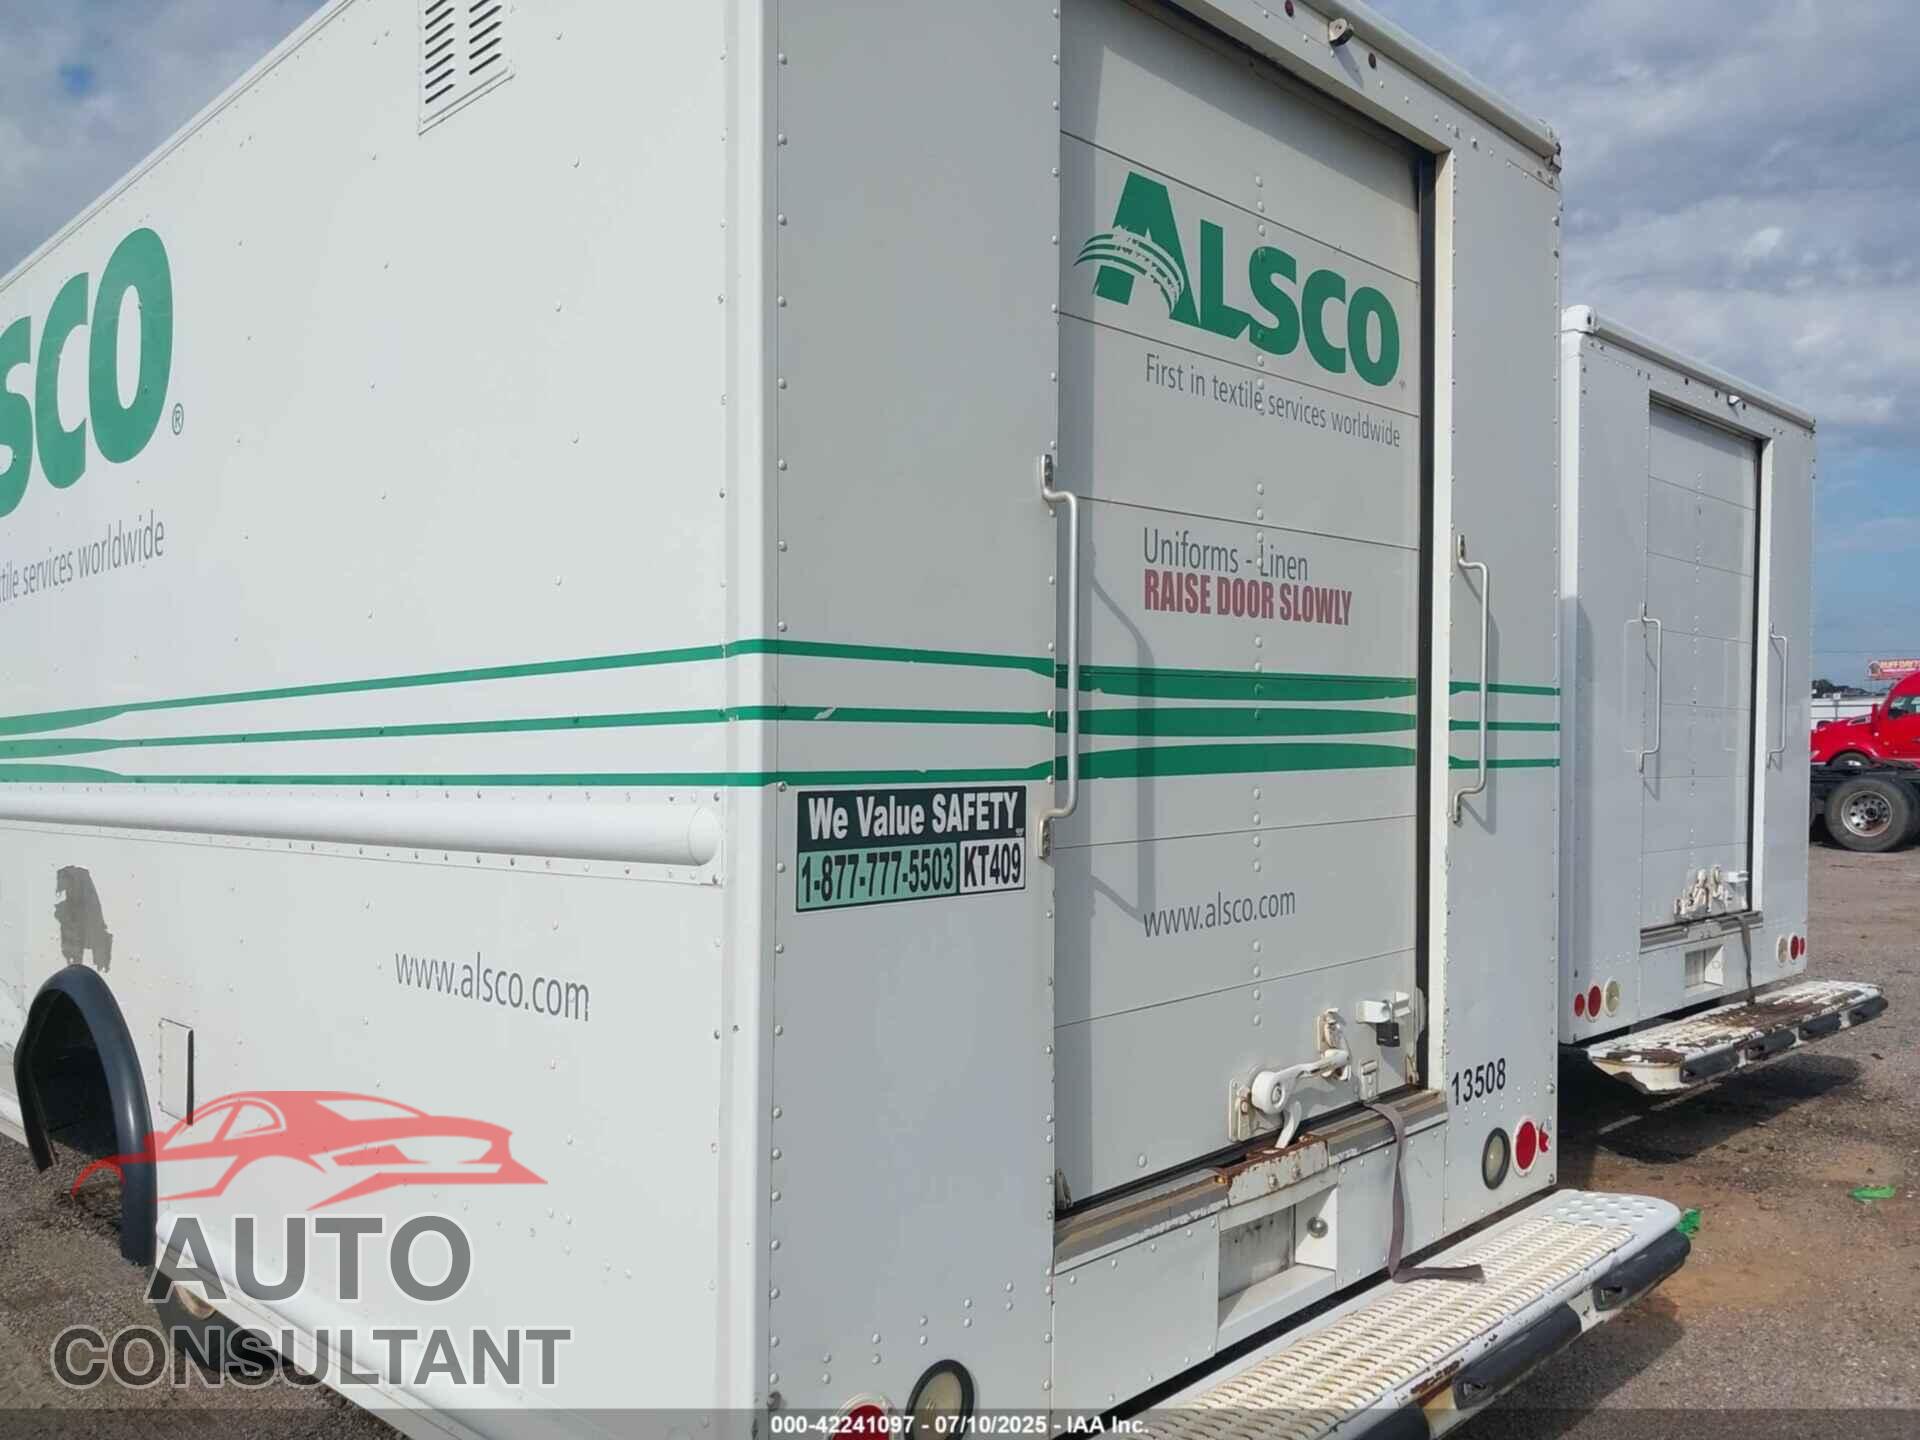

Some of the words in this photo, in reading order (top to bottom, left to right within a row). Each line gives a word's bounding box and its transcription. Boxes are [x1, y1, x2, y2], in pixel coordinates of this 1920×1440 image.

[1074, 170, 1400, 387] ALSCO
[1145, 353, 1184, 391] First
[1190, 366, 1206, 397] in
[1212, 375, 1264, 412] textile
[1268, 394, 1327, 429] services
[1331, 411, 1400, 448] worldwide
[23, 546, 73, 595] services
[78, 509, 165, 579] worldwide
[1144, 527, 1239, 574] Uniforms
[1259, 544, 1308, 581] Linen
[1144, 568, 1211, 615] RAISE
[1217, 576, 1274, 619] DOOR
[1279, 582, 1353, 626] SLOWLY
[808, 797, 848, 841] We
[856, 795, 925, 838] Value
[931, 791, 1018, 834] SAFETY
[964, 842, 1021, 887] KT409
[1143, 891, 1295, 937] www.alsco.com
[395, 951, 589, 1022] www.alsco.com
[1452, 1057, 1506, 1106] 13508
